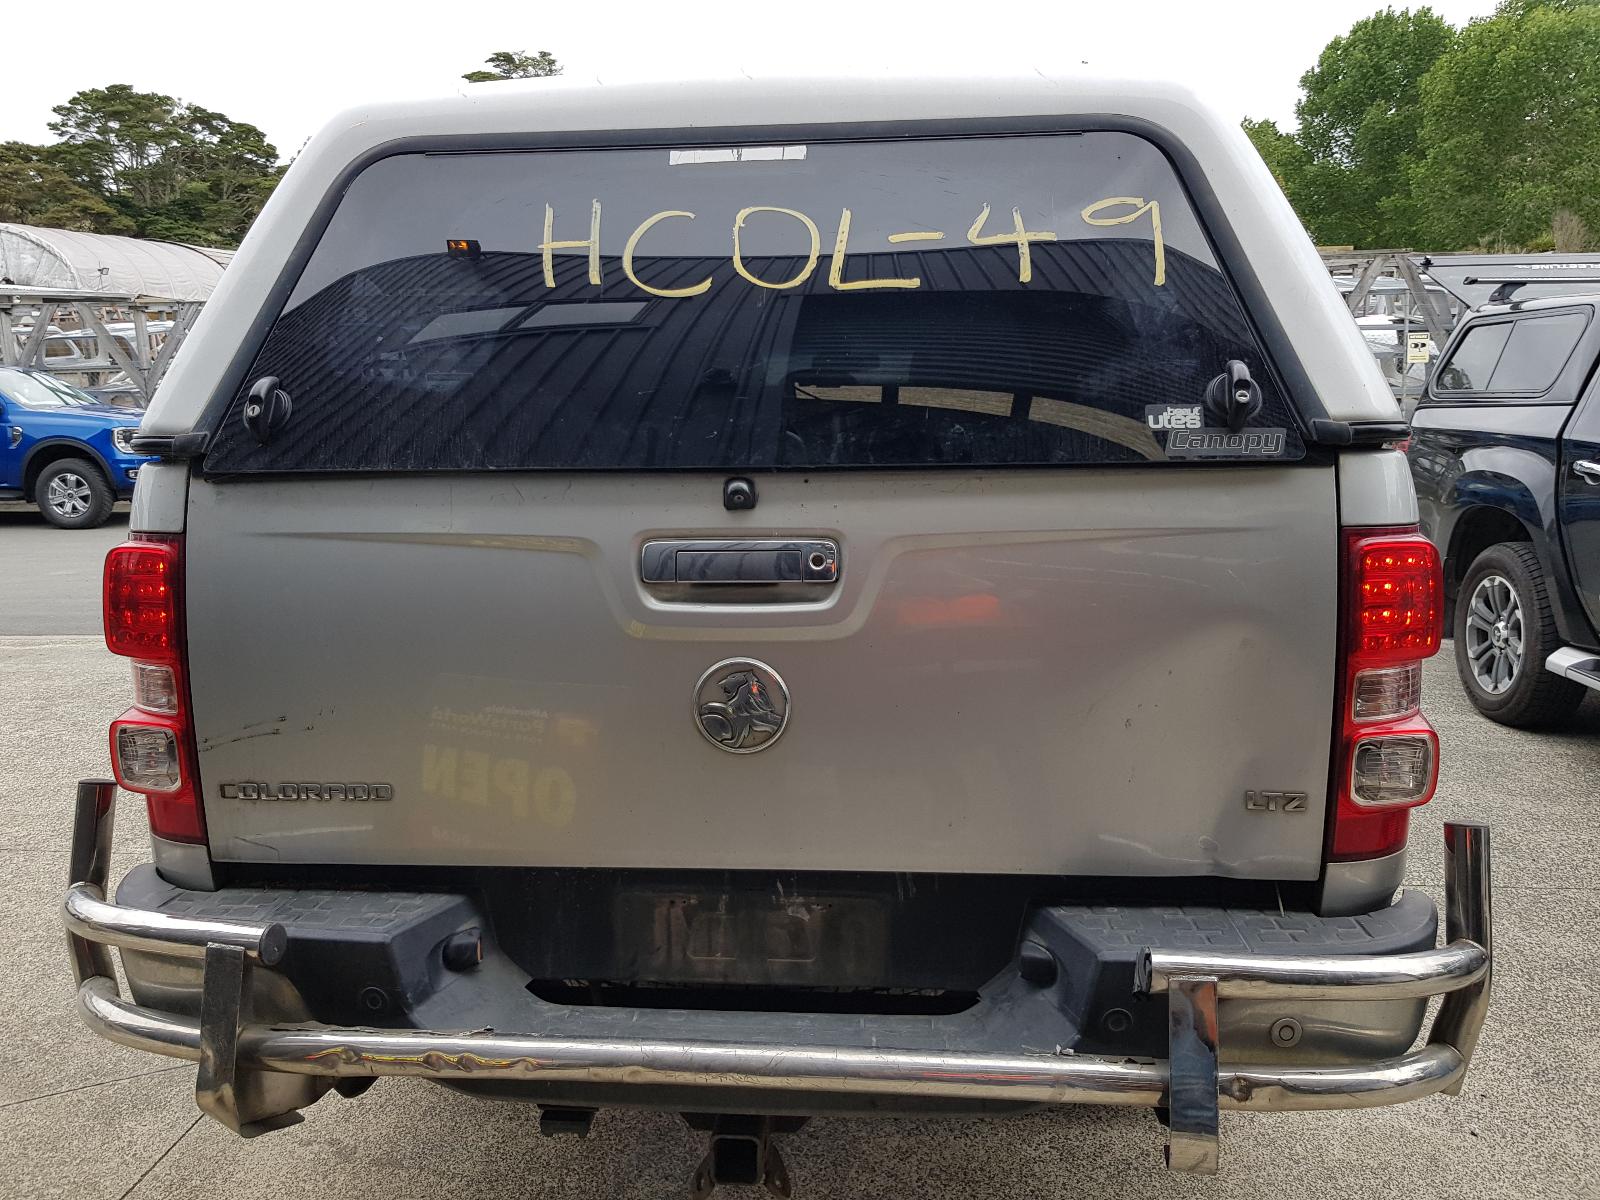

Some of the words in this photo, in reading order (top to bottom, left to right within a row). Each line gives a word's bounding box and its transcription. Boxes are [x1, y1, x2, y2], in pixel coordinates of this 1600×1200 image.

[537, 197, 1165, 297] HCOL-49
[1148, 412, 1201, 429] utes
[1167, 406, 1201, 416] beaut
[1169, 429, 1283, 453] Canopy
[219, 782, 393, 801] COLORADO
[1245, 791, 1306, 812] LTZ
